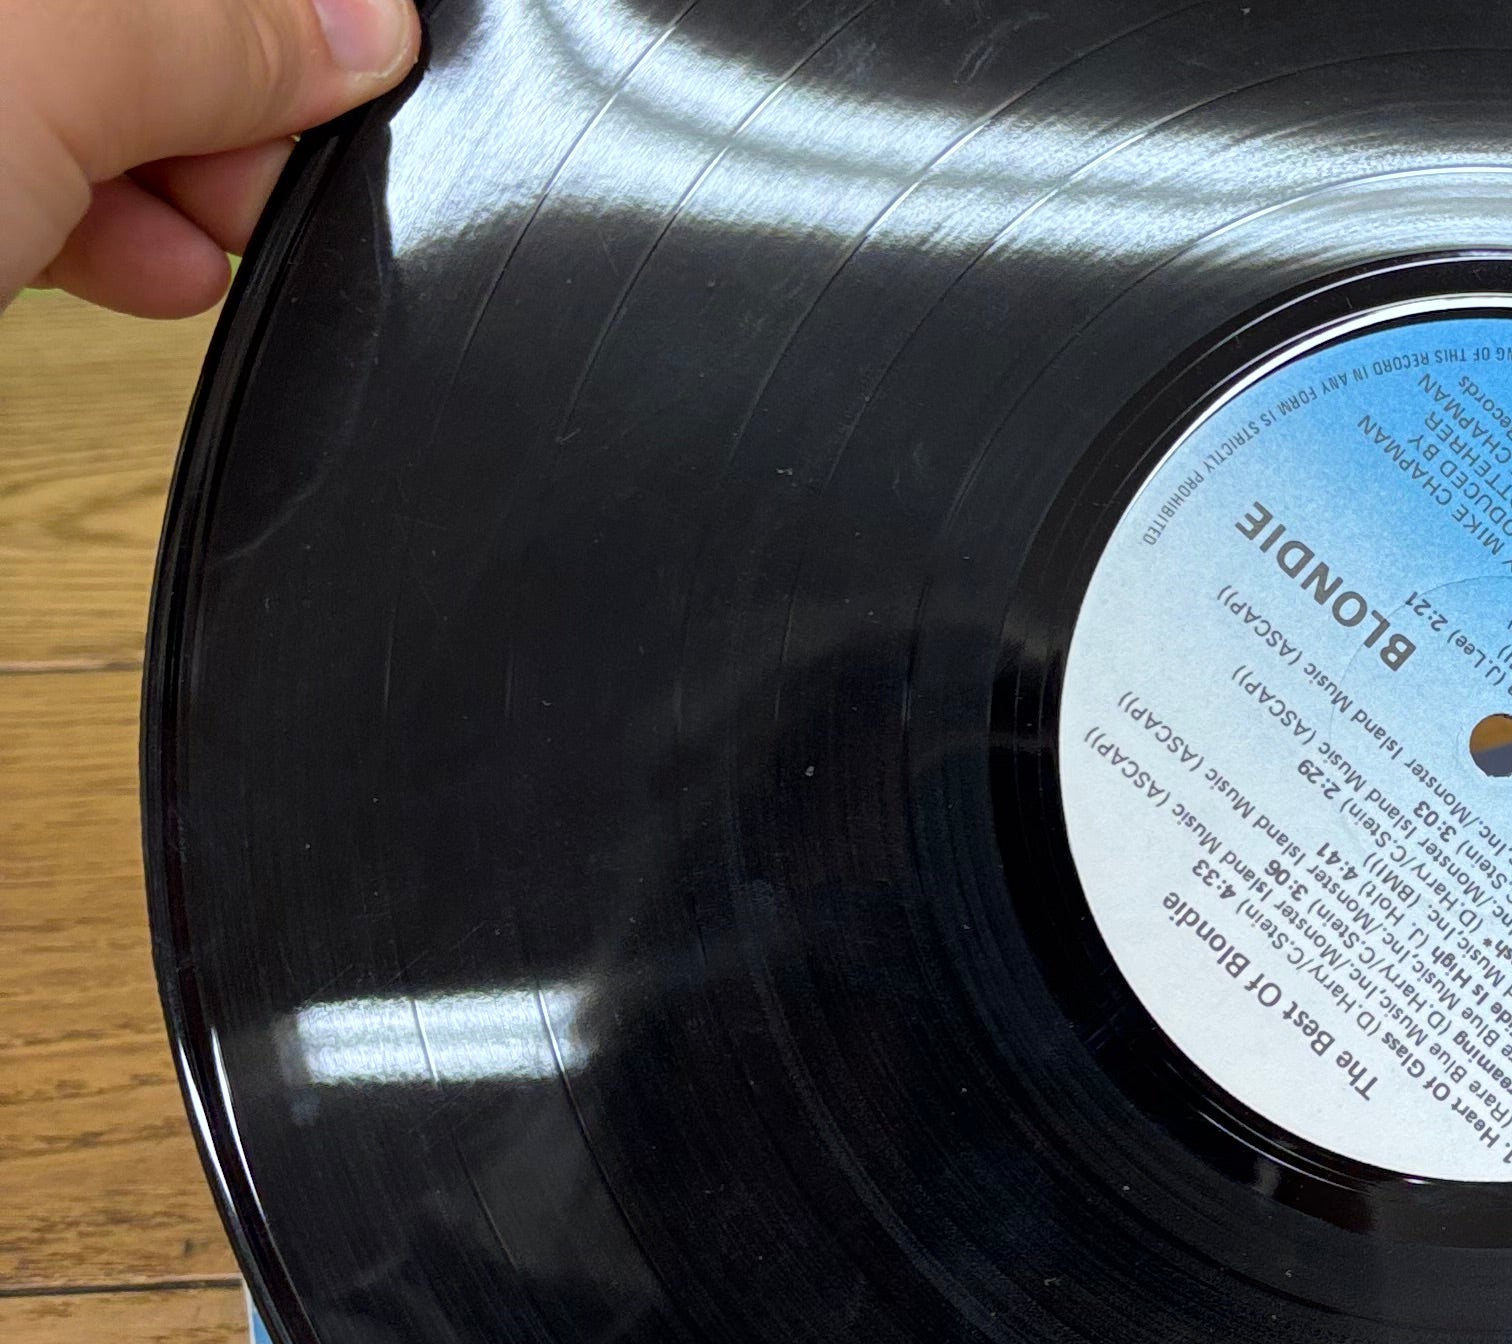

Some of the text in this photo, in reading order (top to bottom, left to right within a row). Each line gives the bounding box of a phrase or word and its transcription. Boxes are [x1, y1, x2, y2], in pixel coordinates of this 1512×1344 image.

[1352, 365, 1368, 381] IN
[1372, 351, 1429, 375] RECORD
[1433, 348, 1466, 363] THIS
[1473, 346, 1490, 361] OF
[1276, 386, 1317, 415] FORM
[1320, 372, 1347, 394] ANY
[1259, 409, 1276, 426] IS
[1417, 373, 1511, 463] CHAPMAN
[1202, 420, 1260, 473] STRICTLY
[1357, 414, 1452, 505] CHAPMAN
[1407, 434, 1440, 461] BY
[1451, 503, 1505, 555] MIKE
[1234, 501, 1416, 671] BLONDIE
[1404, 591, 1448, 631] 2:21
[1216, 584, 1302, 665] (ASCAP))
[1446, 629, 1506, 686] (J.Lee)
[1231, 664, 1316, 745] (ASCAP))
[1303, 662, 1353, 713] Music
[1117, 691, 1204, 771] (ASCAP))
[1349, 708, 1403, 760] Island
[1083, 726, 1170, 807] (ASCAP))
[1297, 759, 1341, 799] 2:29
[1317, 741, 1366, 792] Music
[1204, 768, 1255, 819] Music
[1363, 787, 1417, 839] Island
[1171, 803, 1222, 854] Music
[1251, 814, 1306, 866] Island
[1412, 800, 1456, 842] 3:03
[1191, 859, 1236, 899] 4:33
[1218, 850, 1273, 902] Island
[1264, 859, 1308, 901] 3:06
[1316, 842, 1358, 880] 4:41
[1362, 852, 1421, 908] (BMI))
[1357, 880, 1405, 926] Holt)
[1427, 904, 1505, 987] Music,Inc.
[1431, 945, 1472, 988] High
[1162, 892, 1378, 1101] The Best Of Blondie
[1471, 983, 1489, 1005] Is
[1460, 1006, 1500, 1047] Blue
[1381, 1031, 1425, 1078] Glass
[1428, 1042, 1467, 1083] Blue
[1422, 1076, 1450, 1101] Of
[1450, 1097, 1500, 1148] Heart
